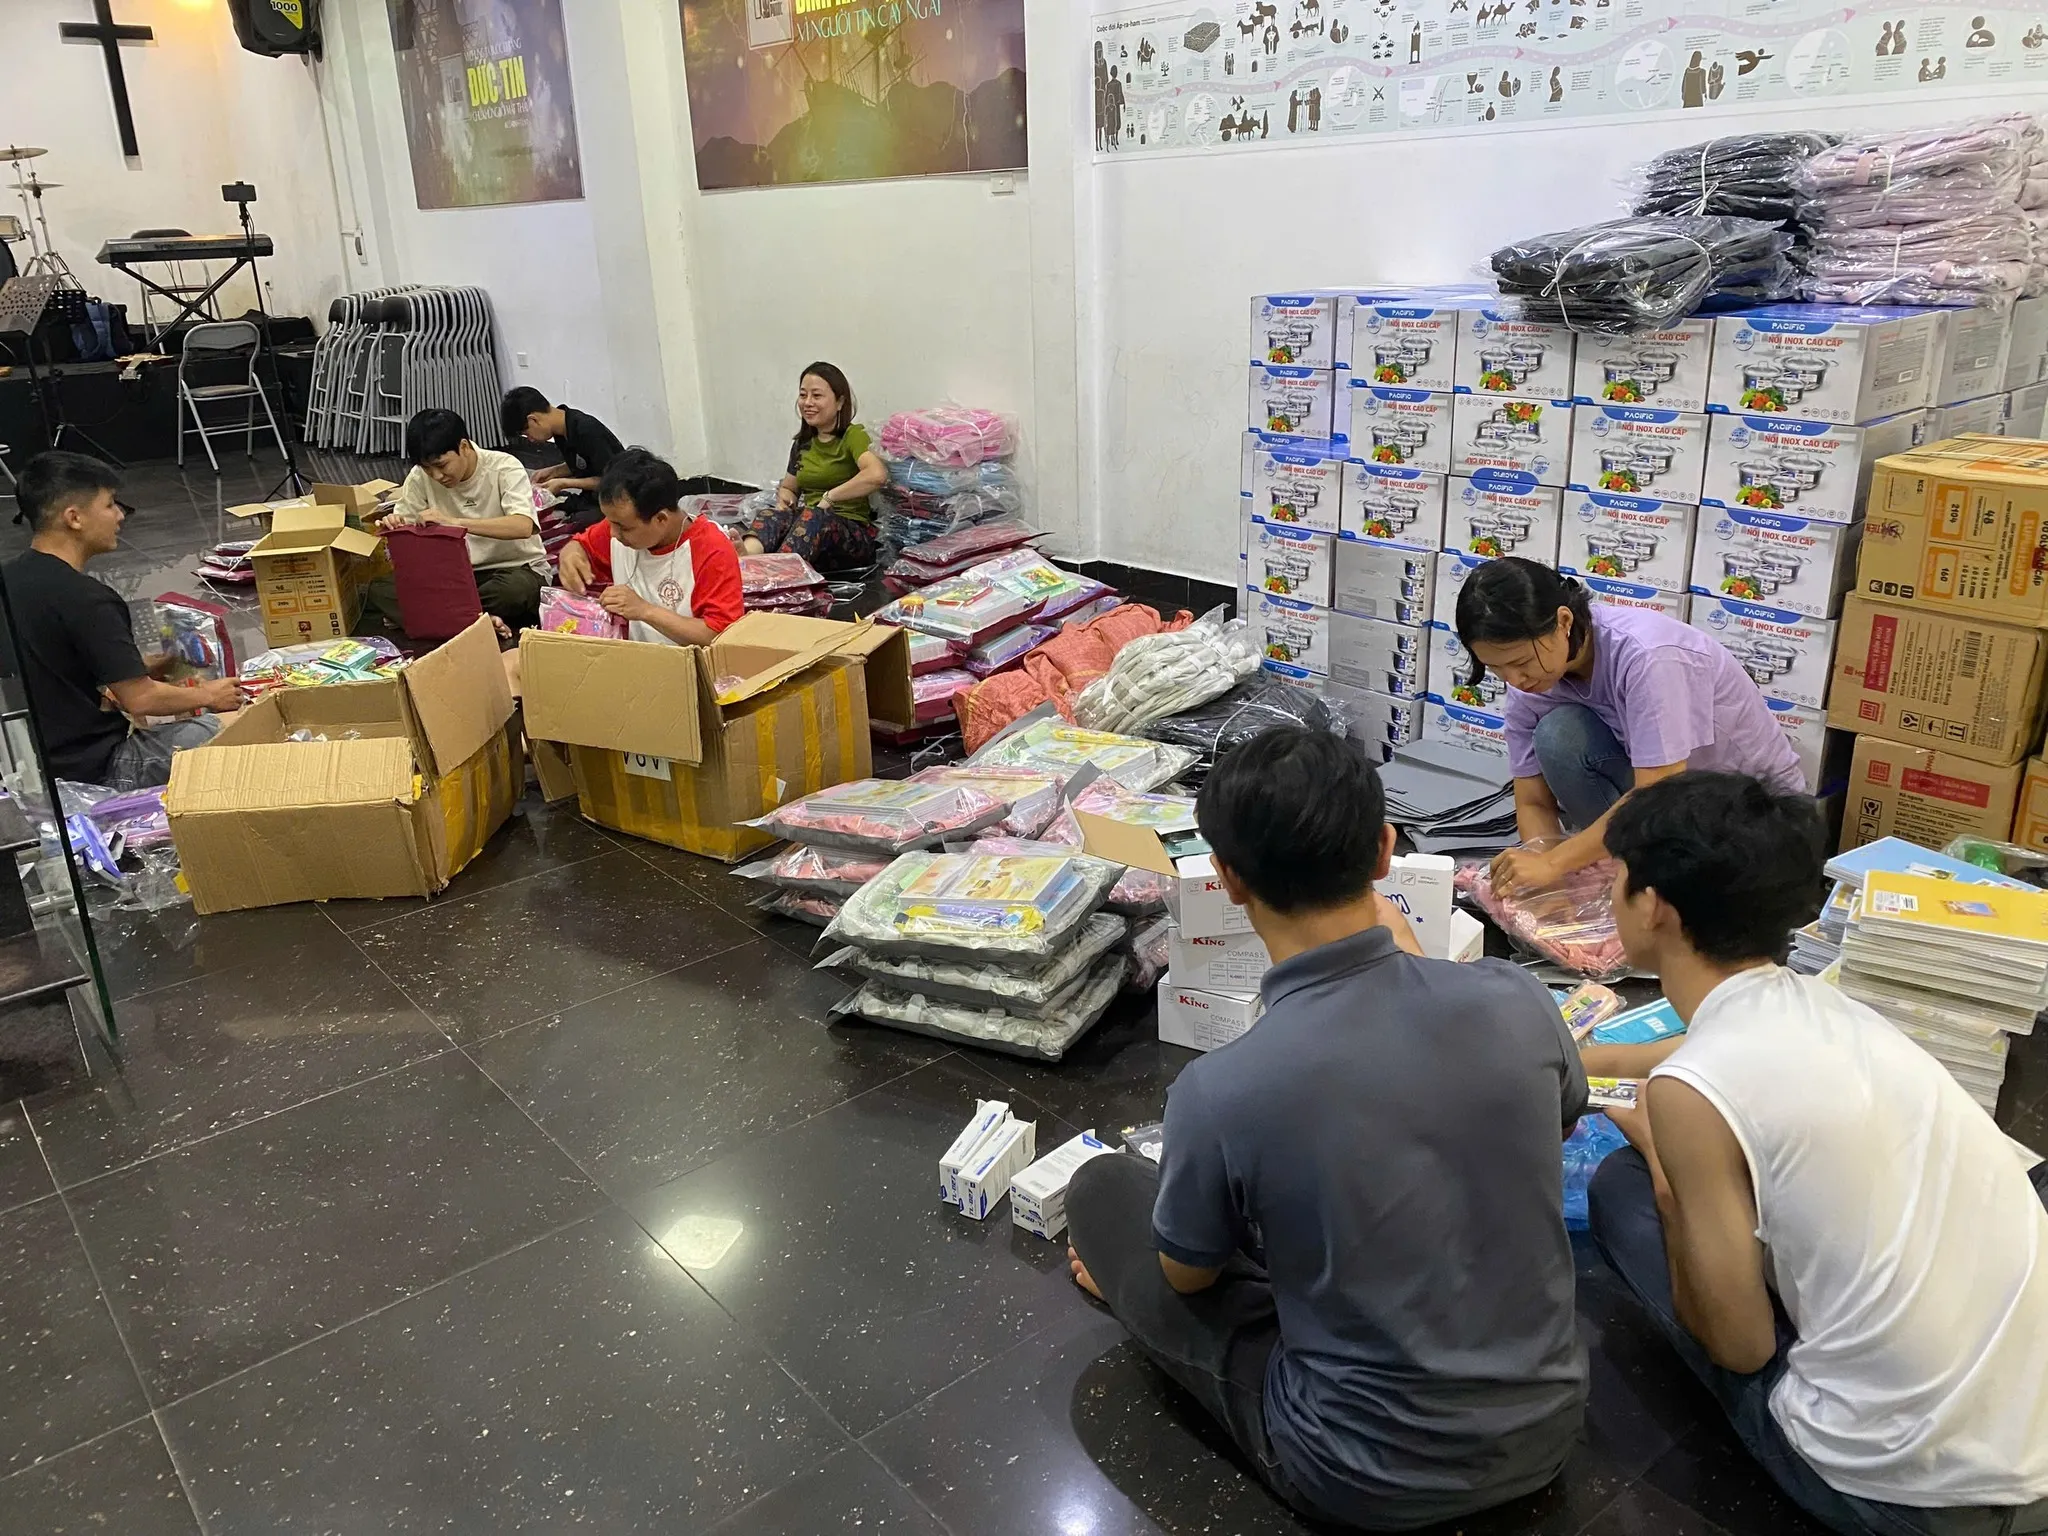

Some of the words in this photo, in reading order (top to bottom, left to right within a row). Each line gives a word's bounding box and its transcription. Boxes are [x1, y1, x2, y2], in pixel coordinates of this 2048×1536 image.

[271, 1, 298, 11] 1000
[499, 55, 527, 100] TIN
[1772, 322, 1805, 331] PACIFIC
[1658, 333, 1674, 341] CAO
[1784, 337, 1804, 346] INOX
[1806, 338, 1824, 347] CAO
[1624, 411, 1654, 420] PACIFIC
[1768, 422, 1802, 432] PACIFIC
[1781, 437, 1801, 446] INOX
[1803, 440, 1820, 448] CAO
[1488, 483, 1514, 492] PACIFIC
[1609, 499, 1638, 508] PACIFIC
[1621, 513, 1637, 521] INOX
[1639, 516, 1654, 524] CAO
[1950, 503, 1960, 523] 2104
[1983, 510, 1995, 525] 48
[1750, 516, 1781, 527] PACIFIC
[1762, 531, 1780, 540] INOX
[1782, 534, 1798, 544] CAO
[1940, 567, 1950, 582] 160
[1606, 584, 1634, 595] PACIFIC
[1617, 599, 1633, 607] INOX
[1635, 601, 1649, 609] CAO
[1744, 607, 1775, 618] PACIFIC
[1756, 623, 1774, 632] INOX
[1776, 626, 1793, 636] CAO
[1462, 714, 1485, 725] PACIFIC
[1226, 950, 1265, 958] COMPASS
[1210, 1014, 1246, 1029] COMPASS
[1017, 1193, 1041, 1209] TL-027
[1021, 1214, 1046, 1229] TL-027
